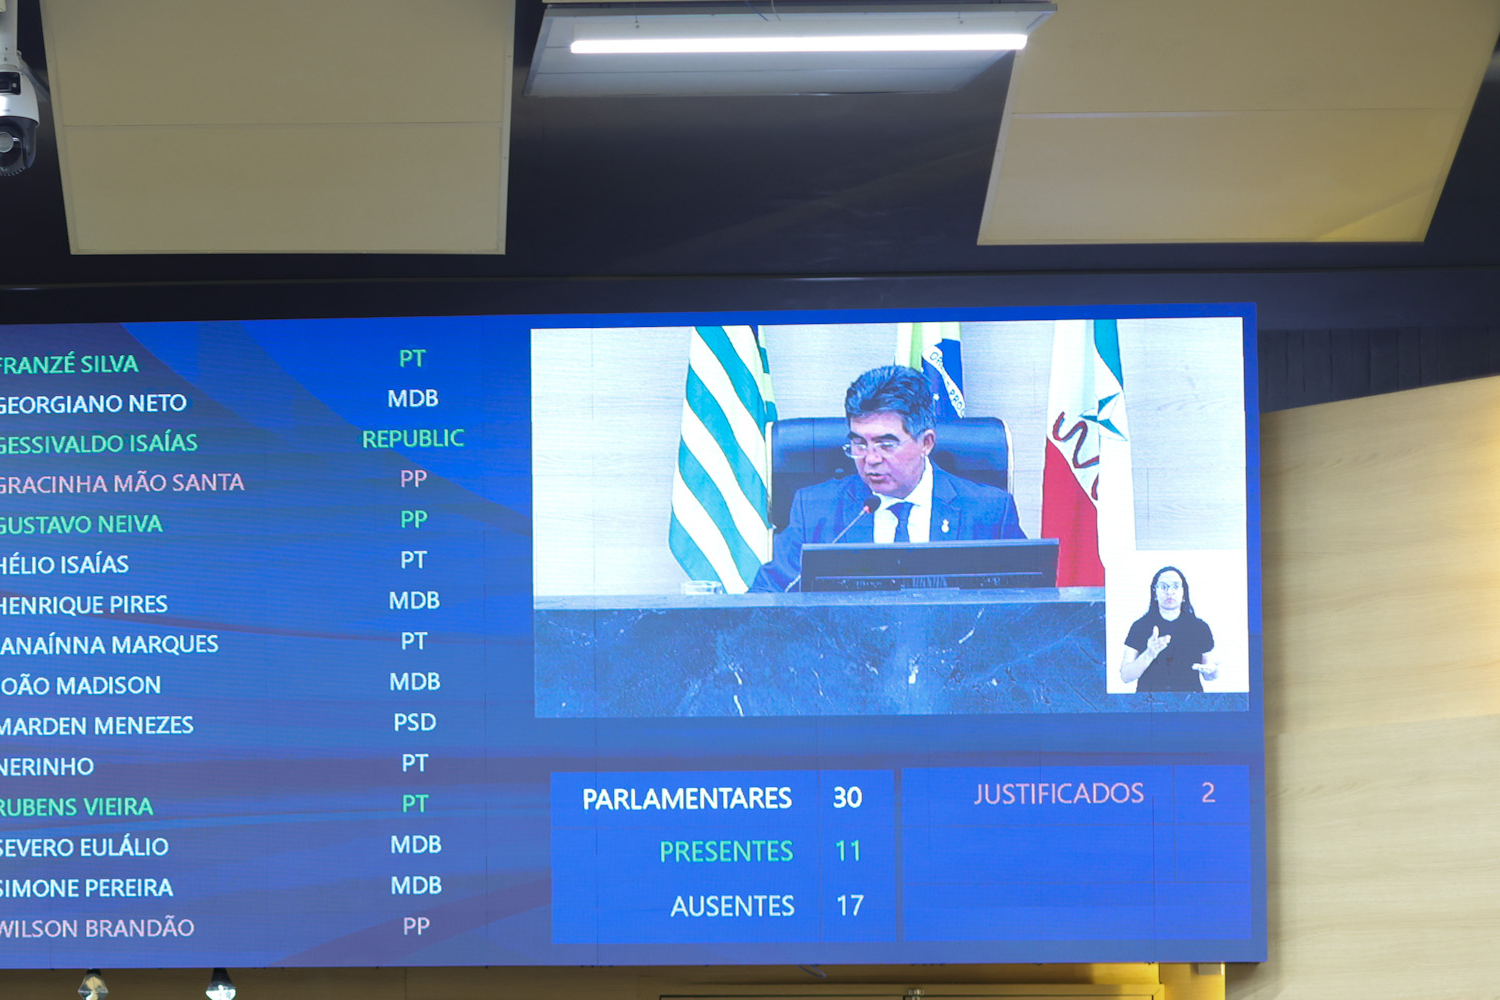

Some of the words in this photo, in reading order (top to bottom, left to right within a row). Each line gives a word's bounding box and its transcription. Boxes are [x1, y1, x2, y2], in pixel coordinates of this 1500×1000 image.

[81, 354, 139, 373] SILVA
[400, 348, 427, 368] PT
[129, 393, 187, 413] NETO
[388, 388, 439, 408] MDB
[130, 428, 198, 452] ISAÍAS
[362, 428, 465, 449] REPUBLIC
[114, 470, 167, 493] MÃO
[172, 472, 245, 492] SANTA
[401, 469, 428, 488] PP
[98, 514, 164, 533] NEIVA
[401, 509, 428, 529] PP
[61, 550, 129, 574] ISAÍAS
[401, 550, 428, 569] PT
[110, 594, 168, 614] PIRES
[389, 590, 441, 610] MDB
[112, 634, 219, 656] MARQUES
[401, 631, 429, 650] PT
[56, 675, 161, 695] MADISON
[390, 671, 441, 691] MDB
[94, 715, 194, 735] MENEZES
[394, 712, 437, 732] PSD
[402, 753, 429, 772] PT
[583, 786, 793, 811] PARLAMENTARES
[833, 785, 863, 809] 30
[973, 782, 1145, 805] JUSTIFICADOS
[1201, 781, 1216, 803] 2
[83, 797, 154, 816] VIEIRA
[402, 794, 429, 813] PT
[80, 832, 169, 857] EULÁLIO
[391, 834, 442, 854] MDB
[660, 840, 794, 863] PRESENTES
[836, 839, 860, 862] 11
[85, 878, 174, 898] PEREIRA
[391, 875, 442, 895] MDB
[670, 894, 795, 918] AUSENTES
[837, 894, 865, 916] 17
[85, 914, 195, 938] BRANDÃO
[403, 916, 430, 936] PP
